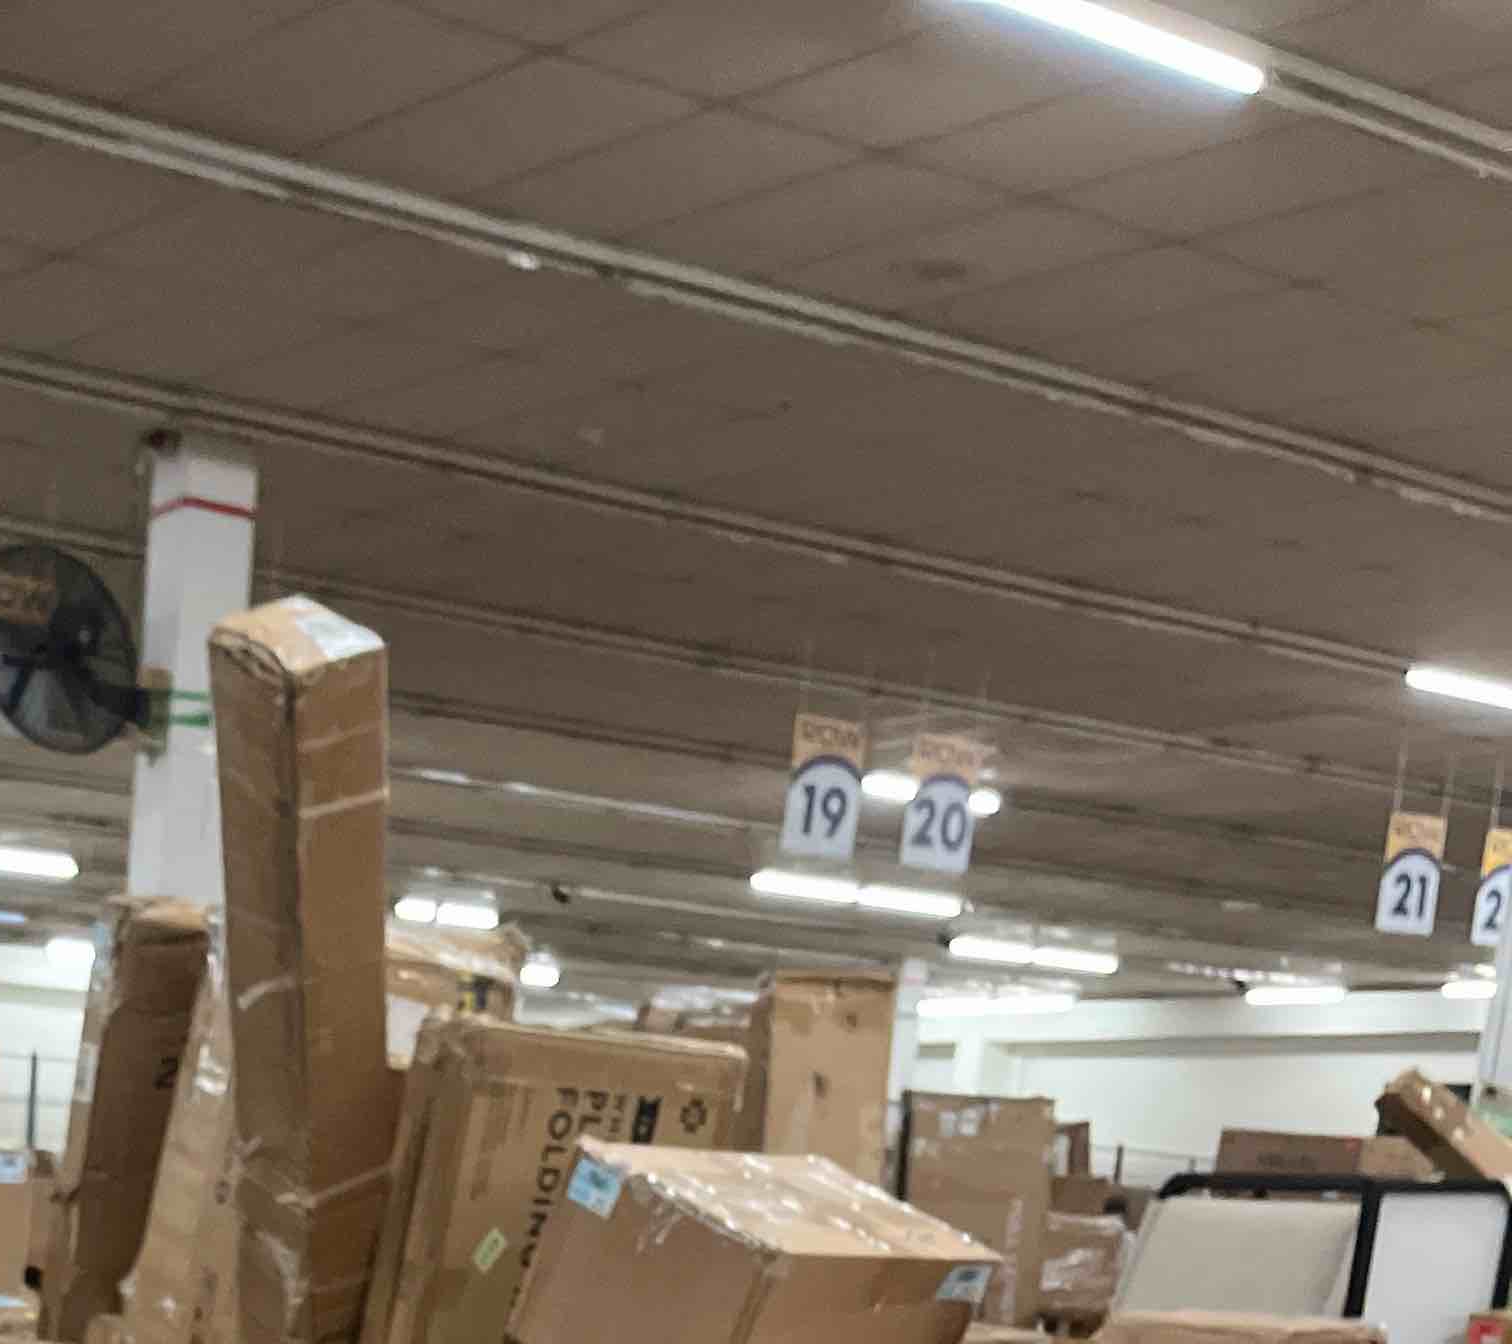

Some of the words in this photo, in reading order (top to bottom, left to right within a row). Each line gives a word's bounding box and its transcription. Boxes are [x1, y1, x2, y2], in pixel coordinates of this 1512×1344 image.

[802, 784, 848, 838] 19
[910, 798, 966, 852] 20
[1392, 873, 1428, 918] 21
[1484, 889, 1503, 931] 2
